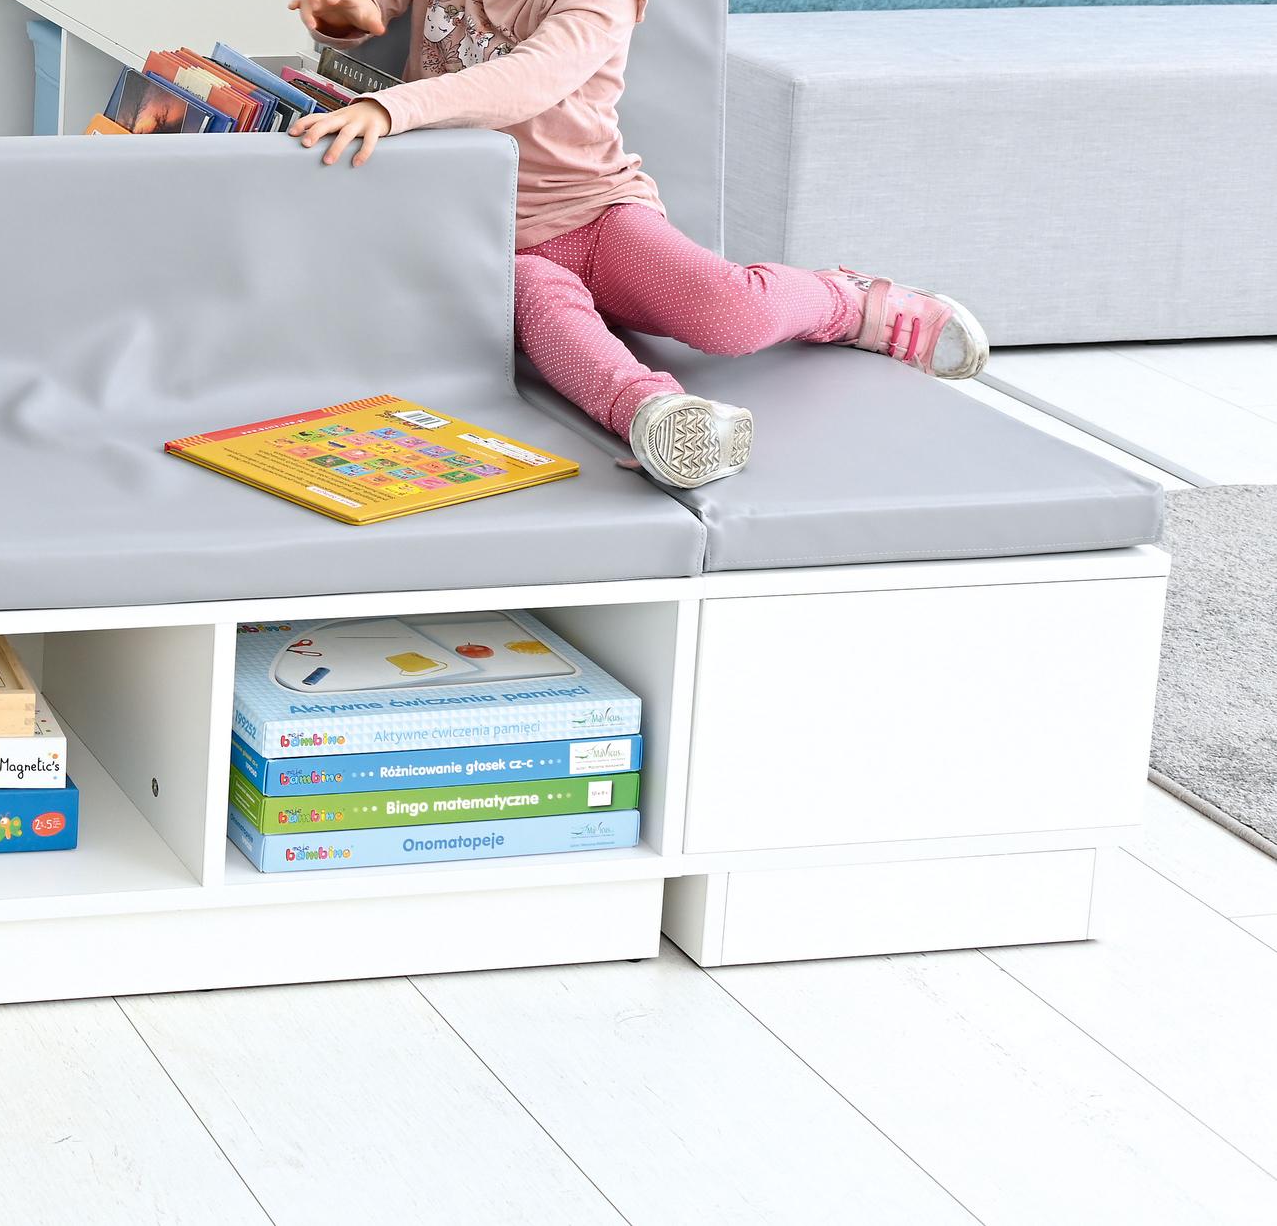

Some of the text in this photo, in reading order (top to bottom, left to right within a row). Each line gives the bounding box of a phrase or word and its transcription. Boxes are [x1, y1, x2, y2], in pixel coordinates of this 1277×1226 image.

[367, 77, 389, 91] POL
[288, 685, 591, 715] Aktywne ćwiczenia pamięci
[280, 733, 346, 748] bambino
[373, 720, 541, 745] Aktywne ćwiczenia pamięci
[0, 757, 60, 780] Magnetic's
[279, 770, 344, 786] bambino
[380, 758, 534, 778] Różnicowanie głosek cz-c
[386, 794, 540, 816] Bingo matematyczne
[278, 809, 344, 824] bambino
[402, 832, 505, 852] Onomatopeje
[285, 846, 351, 862] bambino
